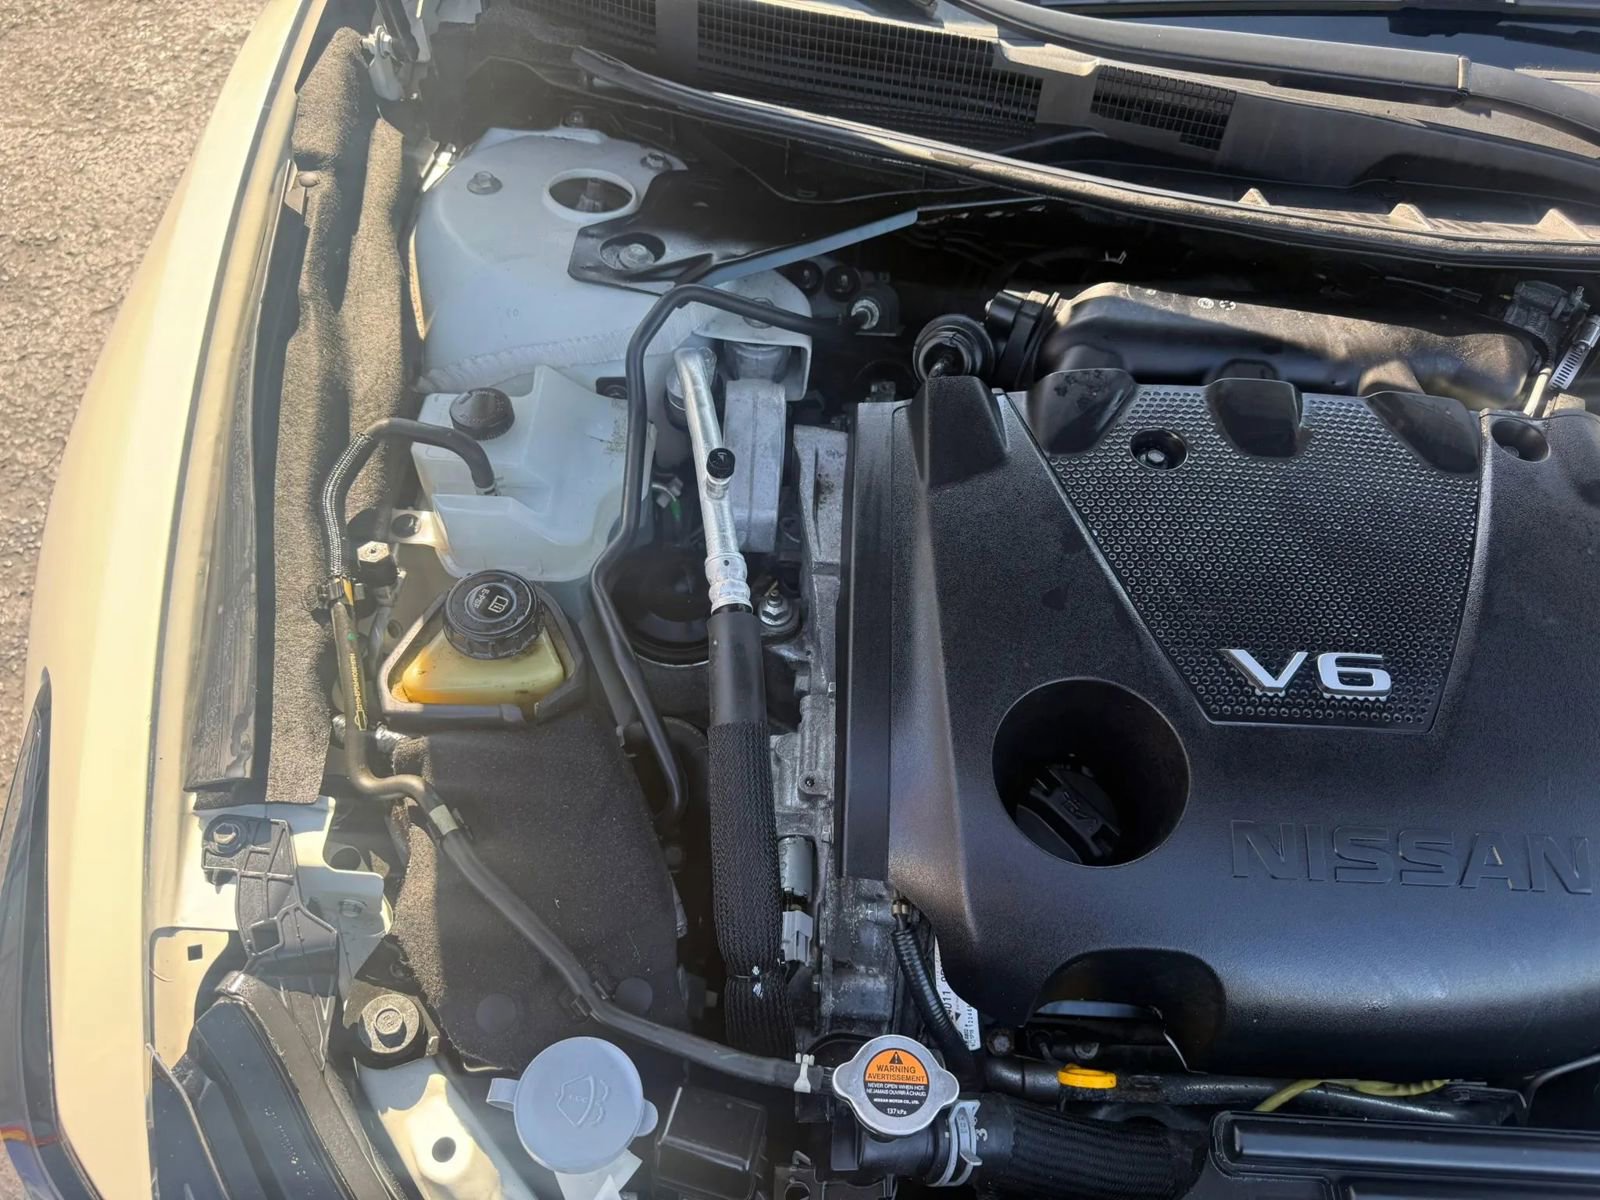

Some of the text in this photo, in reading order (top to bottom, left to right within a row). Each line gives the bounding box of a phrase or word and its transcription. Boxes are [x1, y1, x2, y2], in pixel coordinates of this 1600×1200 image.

[1217, 648, 1392, 698] V6
[1230, 819, 1593, 894] NISSAN
[867, 1073, 925, 1082] AVERTISSEMENT
[876, 1064, 916, 1074] WARNING
